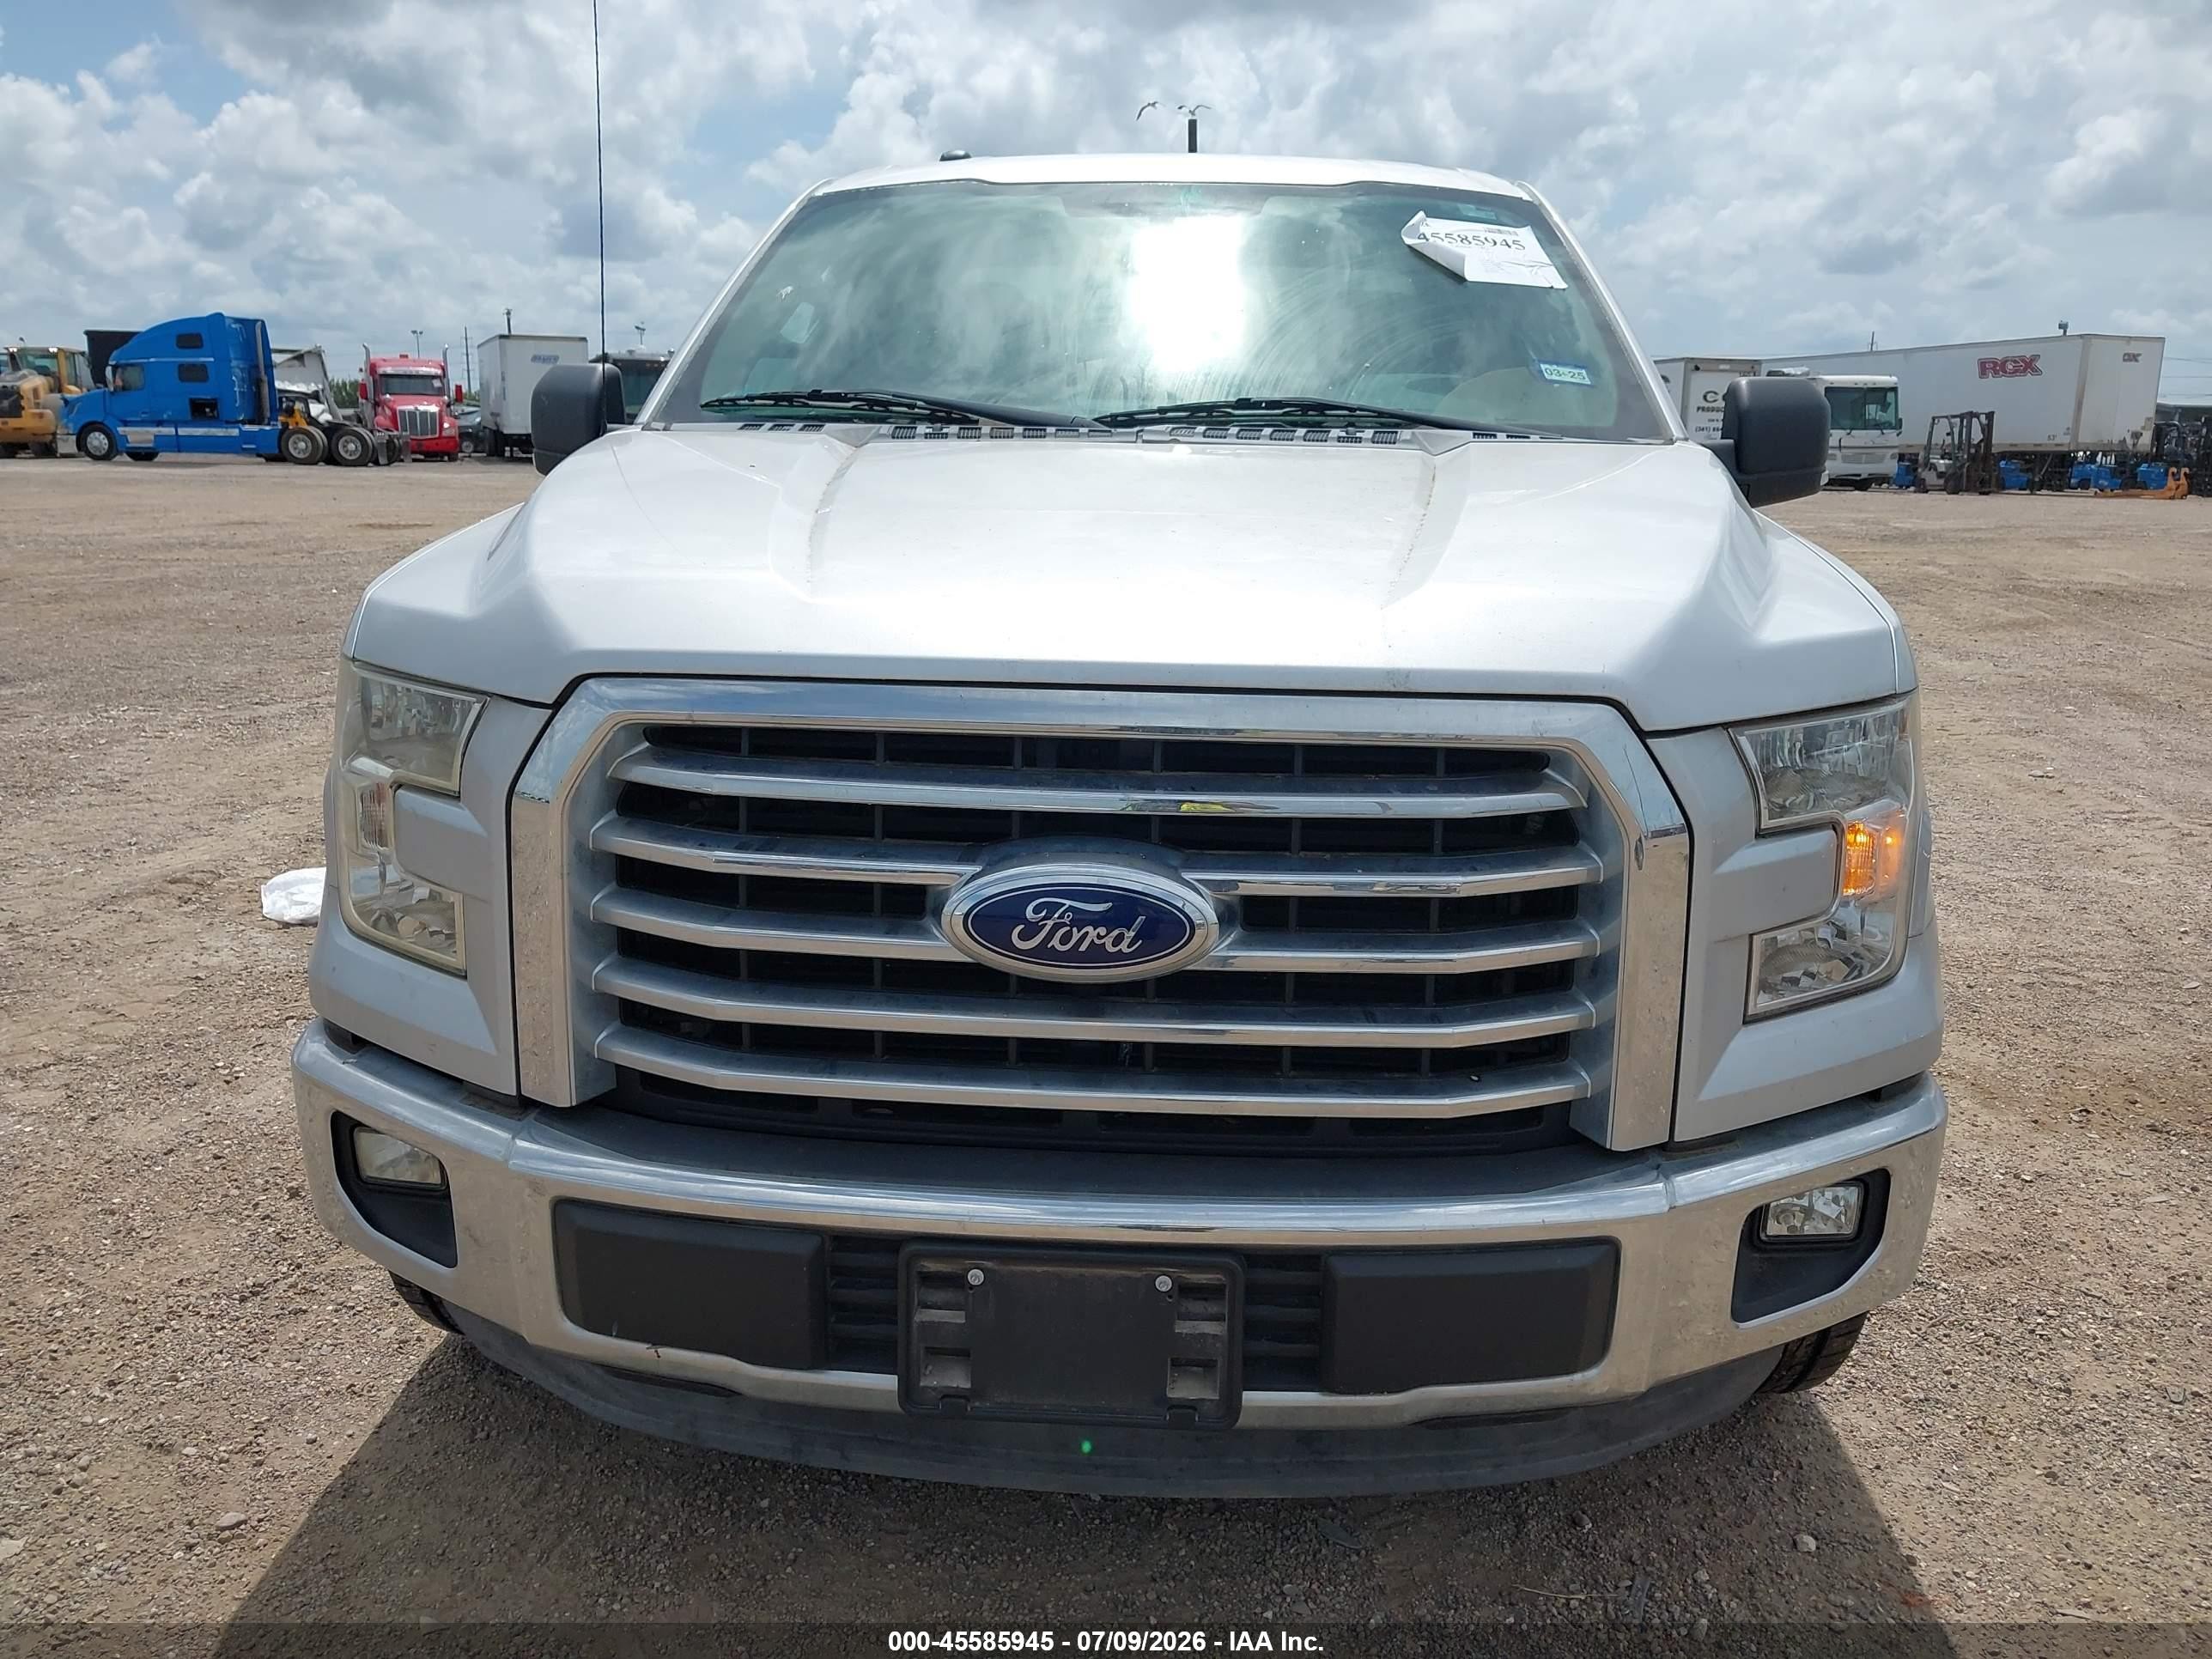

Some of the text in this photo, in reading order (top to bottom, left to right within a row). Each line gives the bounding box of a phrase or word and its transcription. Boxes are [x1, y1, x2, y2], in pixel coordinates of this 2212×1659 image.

[1417, 232, 1526, 251] 45585945
[1978, 354, 2042, 379] RCX
[1011, 897, 1146, 953] Ford
